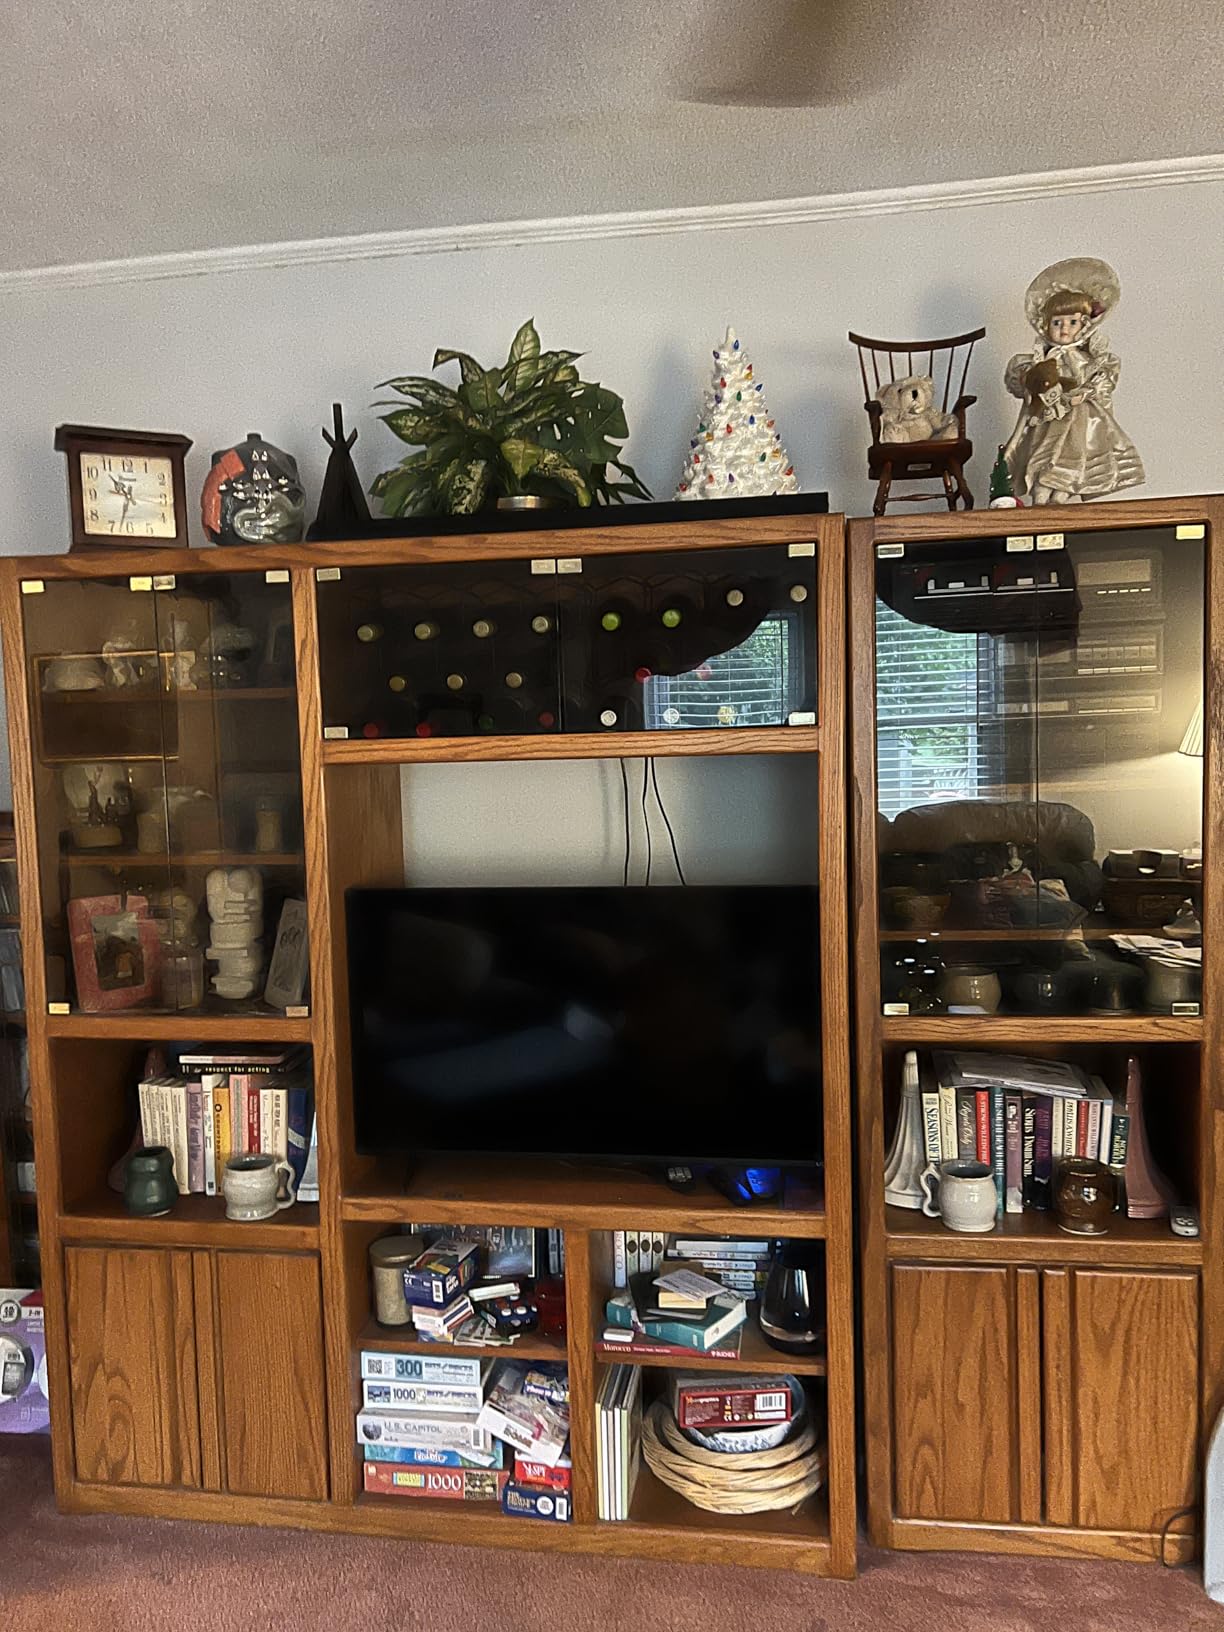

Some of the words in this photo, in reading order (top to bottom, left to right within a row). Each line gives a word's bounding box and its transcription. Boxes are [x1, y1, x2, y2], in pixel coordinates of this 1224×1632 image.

[102, 457, 112, 472] 11
[122, 459, 134, 473] 12
[144, 461, 148, 474] 1
[86, 466, 99, 481] 10
[157, 473, 166, 486] 2
[89, 488, 97, 501] 9
[159, 493, 167, 507] 3
[90, 509, 99, 522] 8
[160, 511, 166, 523] 4
[108, 520, 115, 533] 7
[126, 521, 134, 535] 6
[146, 522, 154, 535] 5
[994, 1093, 1005, 1108] THE
[959, 1101, 973, 1127] Regrets
[1065, 1101, 1075, 1124] PHYLLIS
[925, 1107, 942, 1143] SEASONS
[994, 1109, 1005, 1133] SOUTH
[960, 1126, 974, 1145] Only
[928, 1143, 942, 1154] OF
[994, 1134, 1005, 1158] BEACH
[1111, 1135, 1121, 1163] ROBERTS
[1119, 1139, 1127, 1160] NORA
[994, 1159, 1005, 1176] DIET
[603, 1343, 632, 1353] Morocco
[397, 1359, 422, 1377] 300
[393, 1388, 416, 1401] 1000
[404, 1423, 442, 1434] CAPITOL
[427, 1473, 462, 1491] 1000
